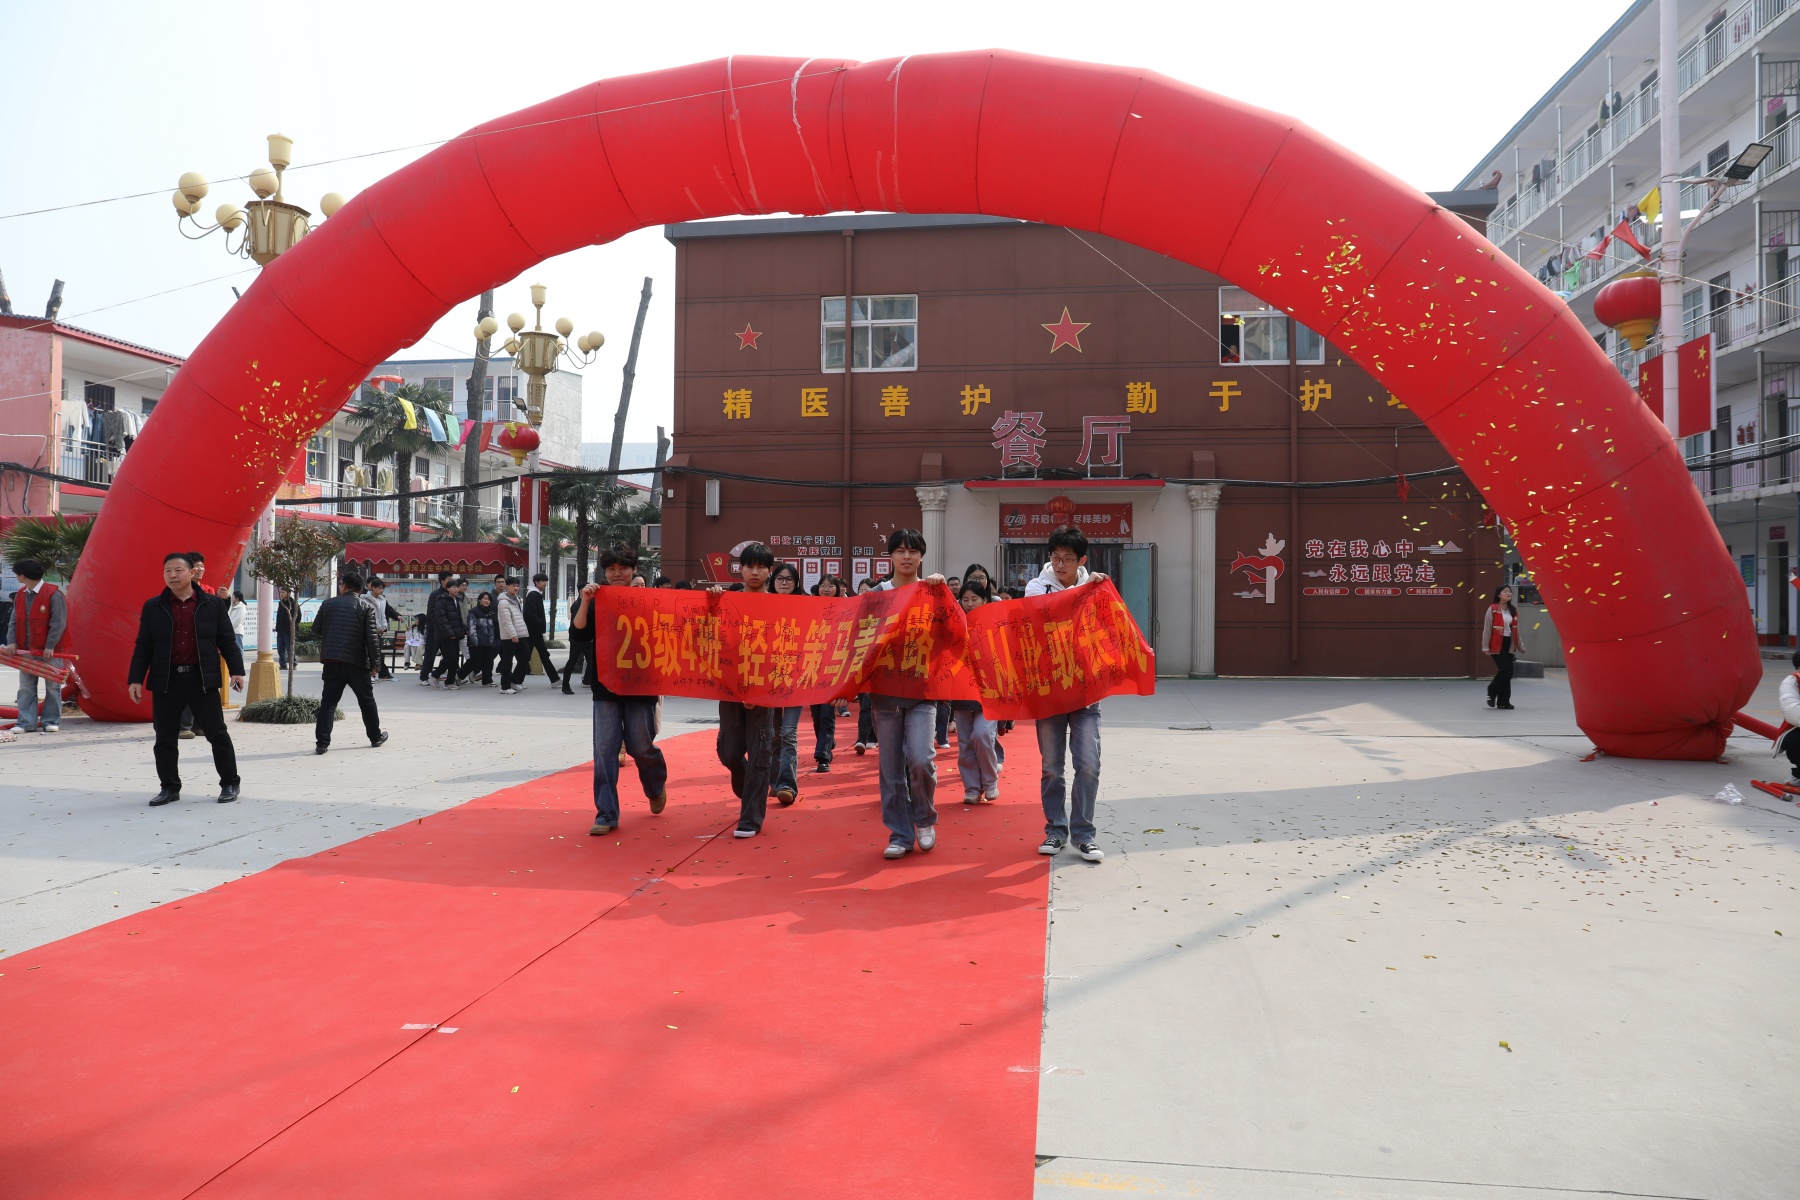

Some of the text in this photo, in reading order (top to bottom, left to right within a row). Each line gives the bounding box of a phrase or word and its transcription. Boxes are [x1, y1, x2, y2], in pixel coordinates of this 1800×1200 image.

[722, 385, 992, 420] 精医善护
[991, 409, 1131, 467] 餐厅
[770, 536, 836, 545] 强化五个引领
[1305, 539, 1414, 558] 党在我心中
[1329, 563, 1435, 582] 永远跟党走
[616, 609, 723, 679] 23级4班
[737, 603, 935, 689] 轻装策马青云路
